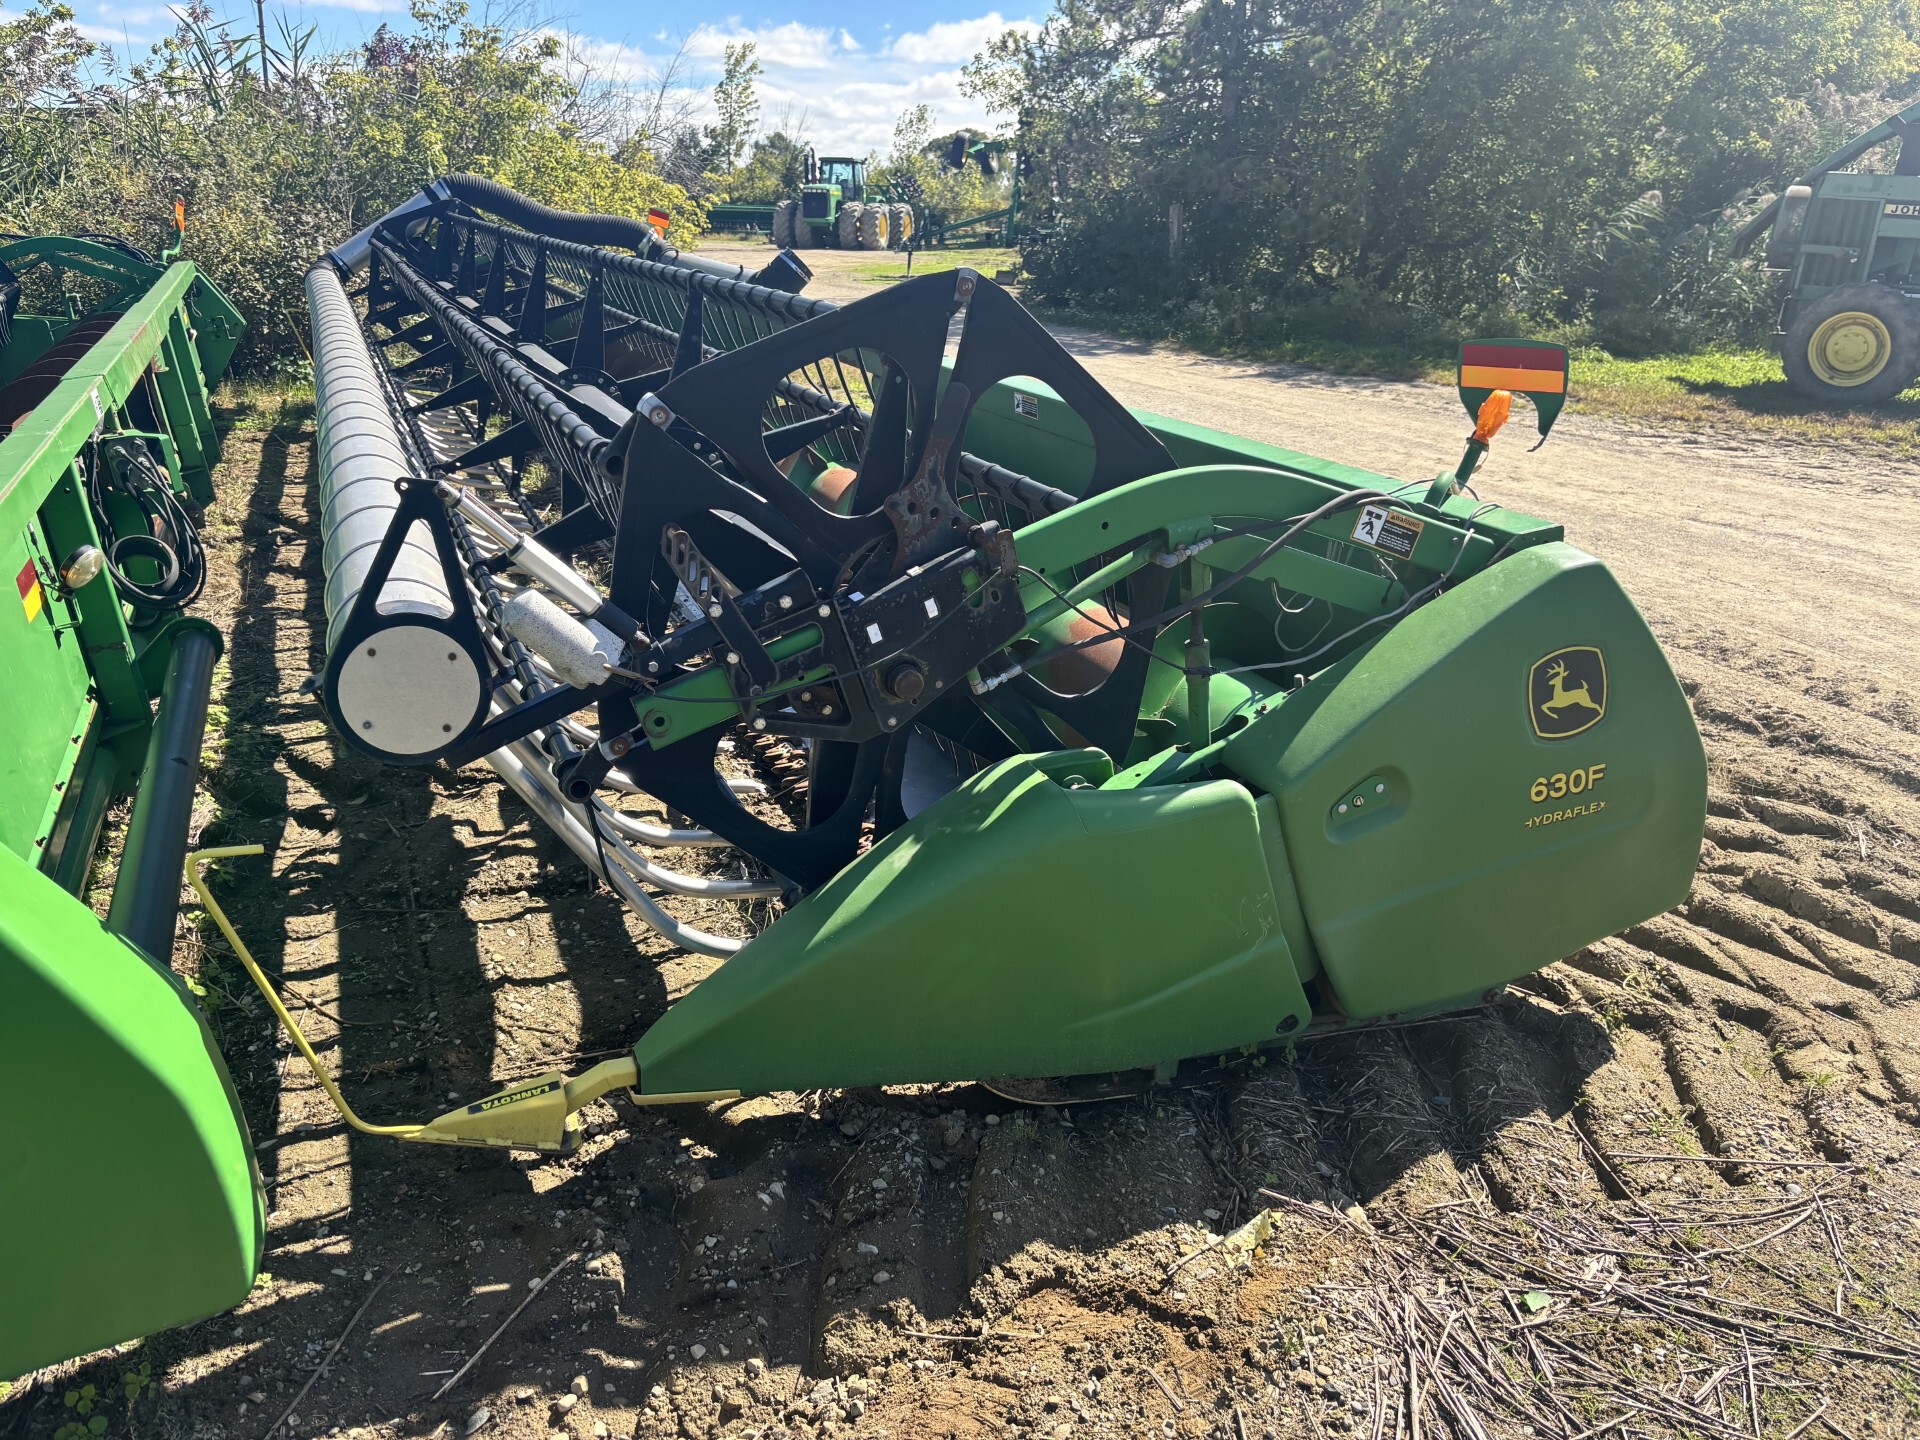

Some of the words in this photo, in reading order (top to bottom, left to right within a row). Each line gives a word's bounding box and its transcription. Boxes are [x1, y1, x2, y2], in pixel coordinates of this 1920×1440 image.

[1395, 514, 1420, 529] WARNING
[1530, 763, 1606, 802] 630F
[481, 1085, 550, 1110] LANKOTA
